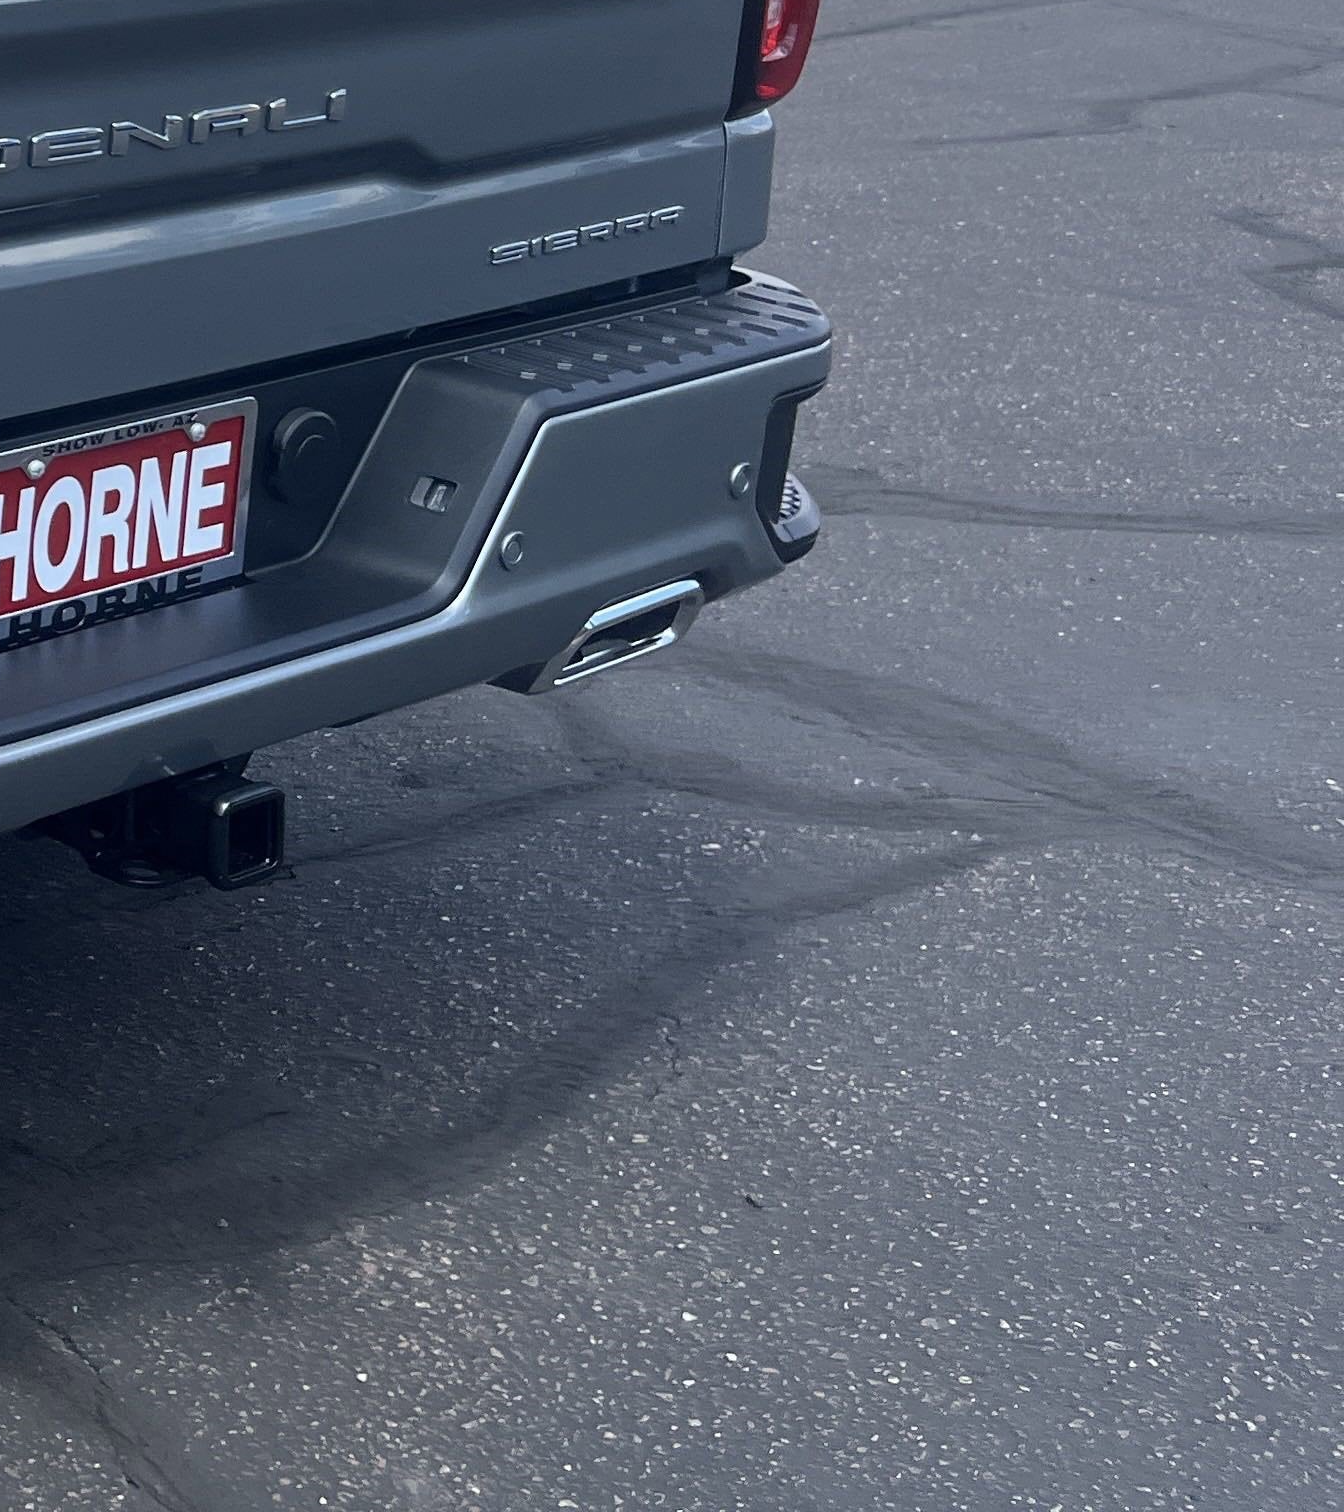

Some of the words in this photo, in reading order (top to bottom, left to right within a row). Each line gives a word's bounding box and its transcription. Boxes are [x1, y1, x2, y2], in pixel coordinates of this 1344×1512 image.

[488, 204, 686, 265] SIERRA
[42, 433, 105, 458] SHOW
[172, 411, 199, 428] AZ
[9, 565, 204, 642] HORNE
